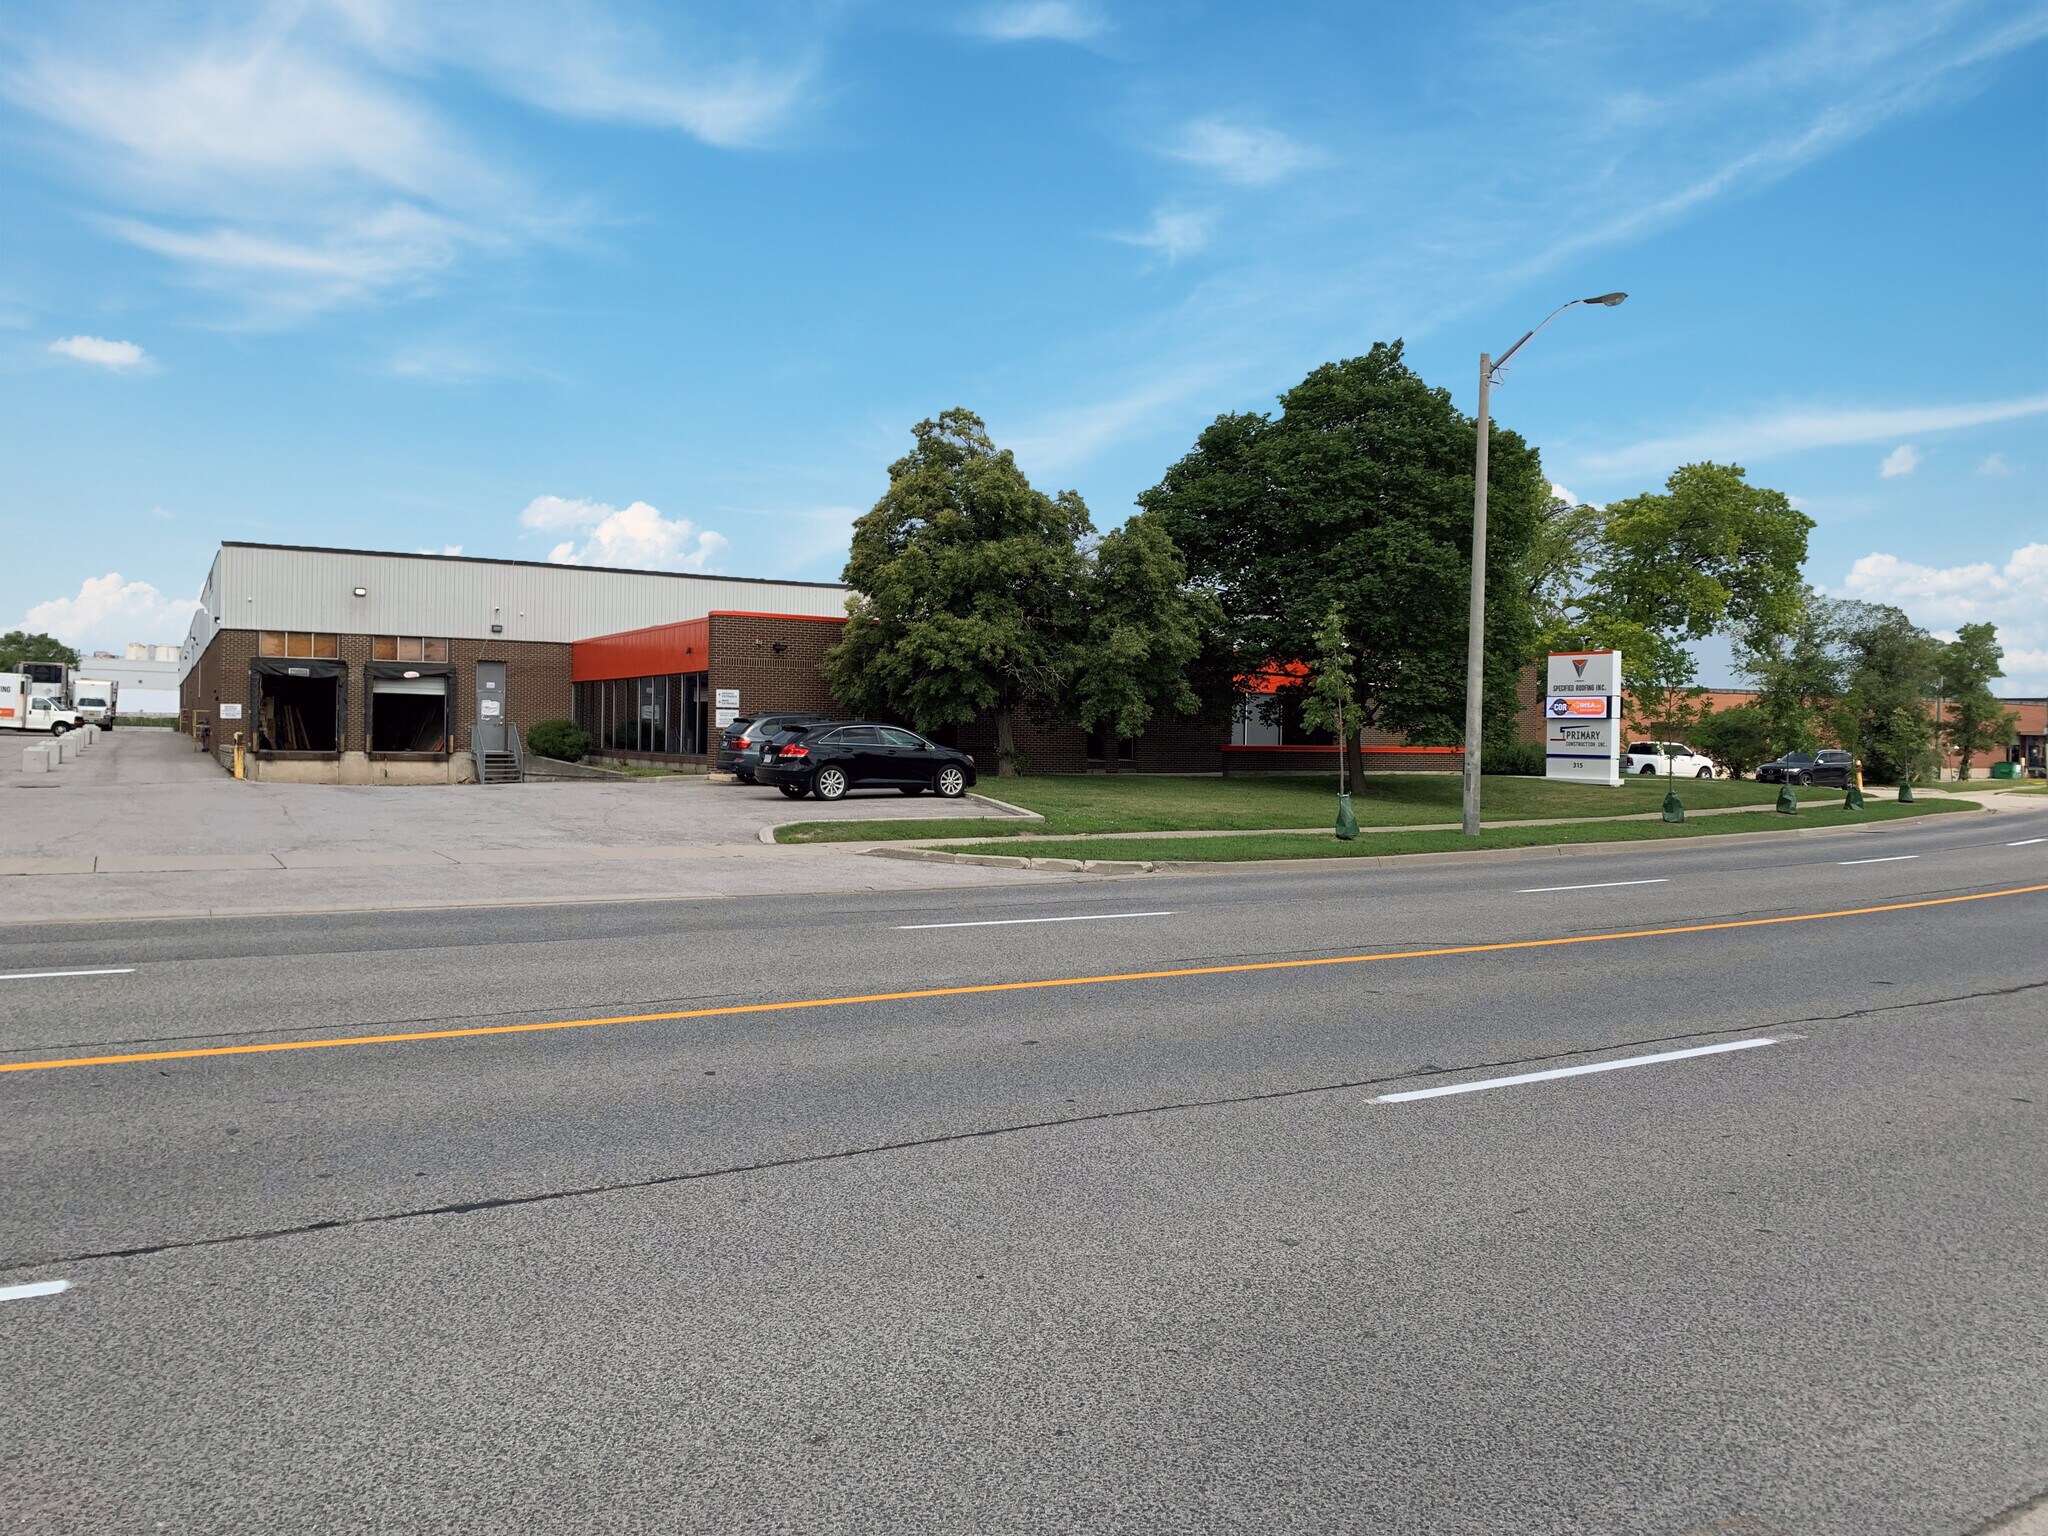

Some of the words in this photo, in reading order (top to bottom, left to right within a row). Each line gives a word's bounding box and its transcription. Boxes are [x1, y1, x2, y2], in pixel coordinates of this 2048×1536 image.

[1553, 684, 1574, 692] SPECIFIED
[1554, 703, 1567, 711] COR
[1566, 730, 1600, 740] PRIMARY
